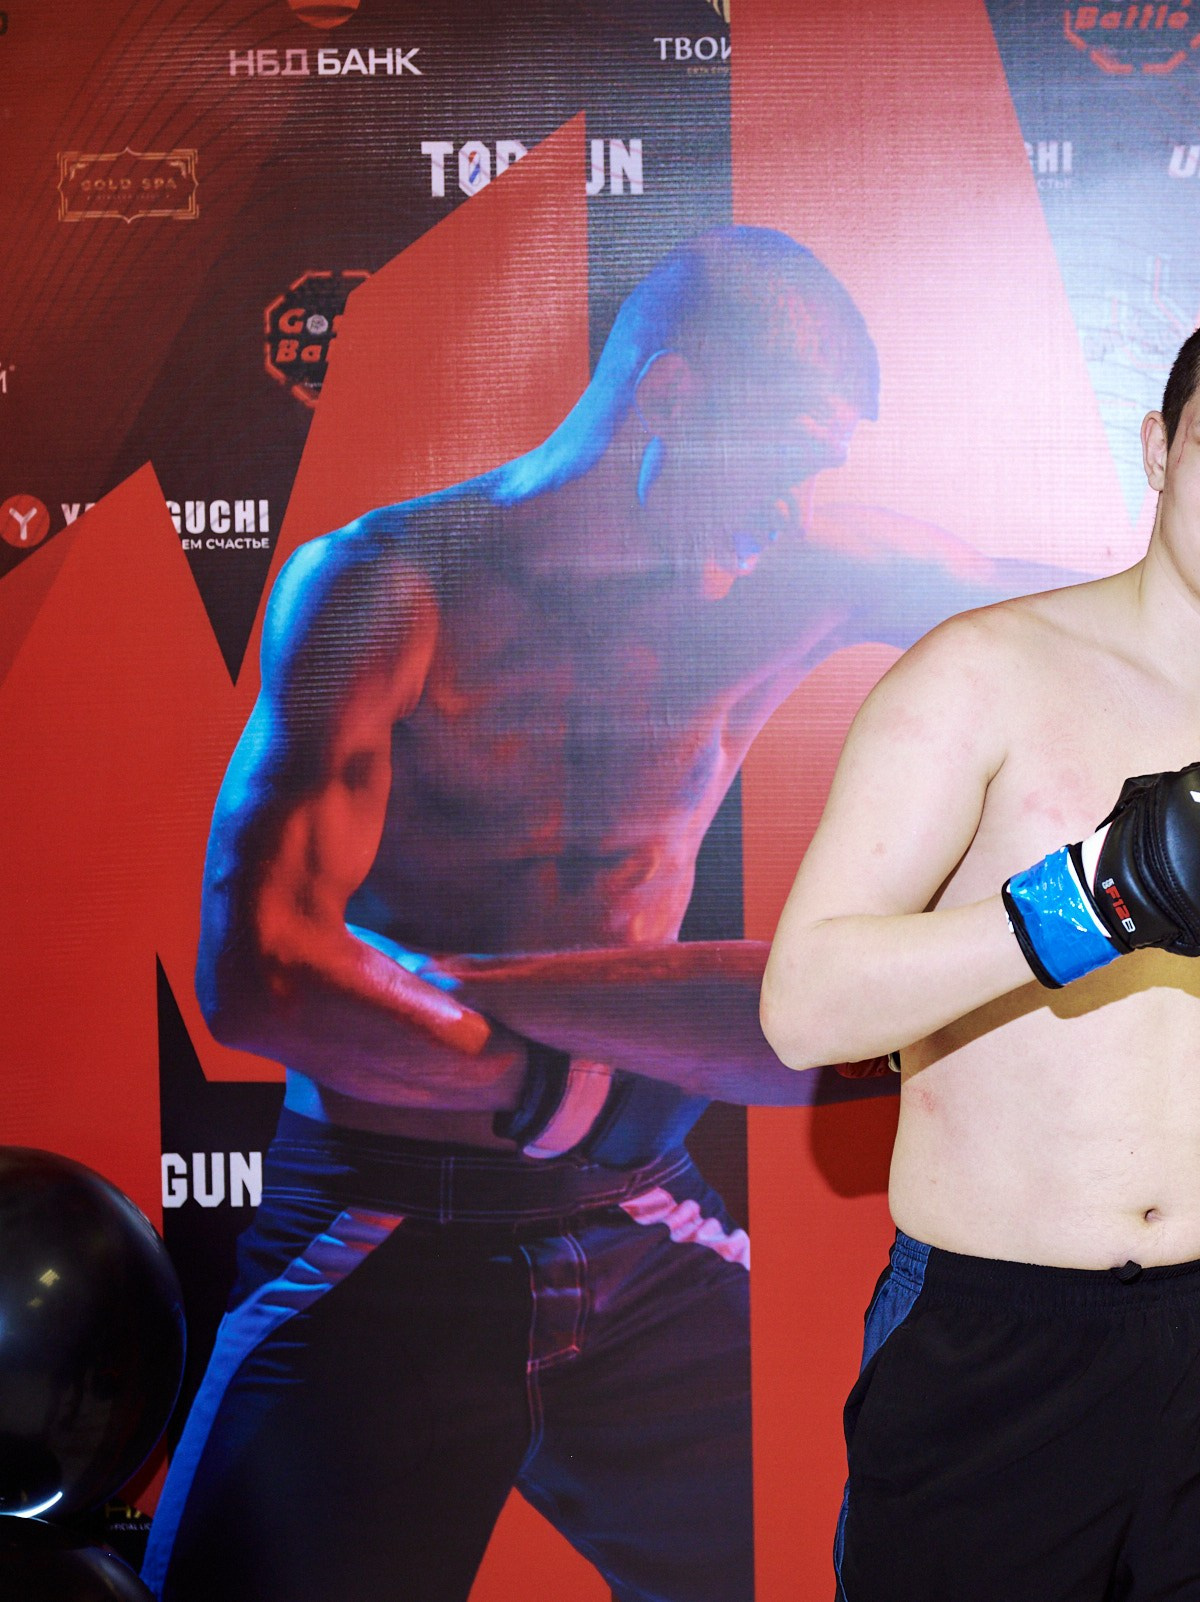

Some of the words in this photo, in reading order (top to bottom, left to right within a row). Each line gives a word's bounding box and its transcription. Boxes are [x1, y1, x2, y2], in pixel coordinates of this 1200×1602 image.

[1074, 4, 1189, 30] Battle
[229, 49, 310, 76] НБД
[317, 47, 423, 76] БАНК
[81, 179, 132, 191] GOLD
[141, 177, 177, 190] SPA
[206, 537, 270, 550] СЧАСТЬЕ
[161, 1151, 263, 1208] GUN
